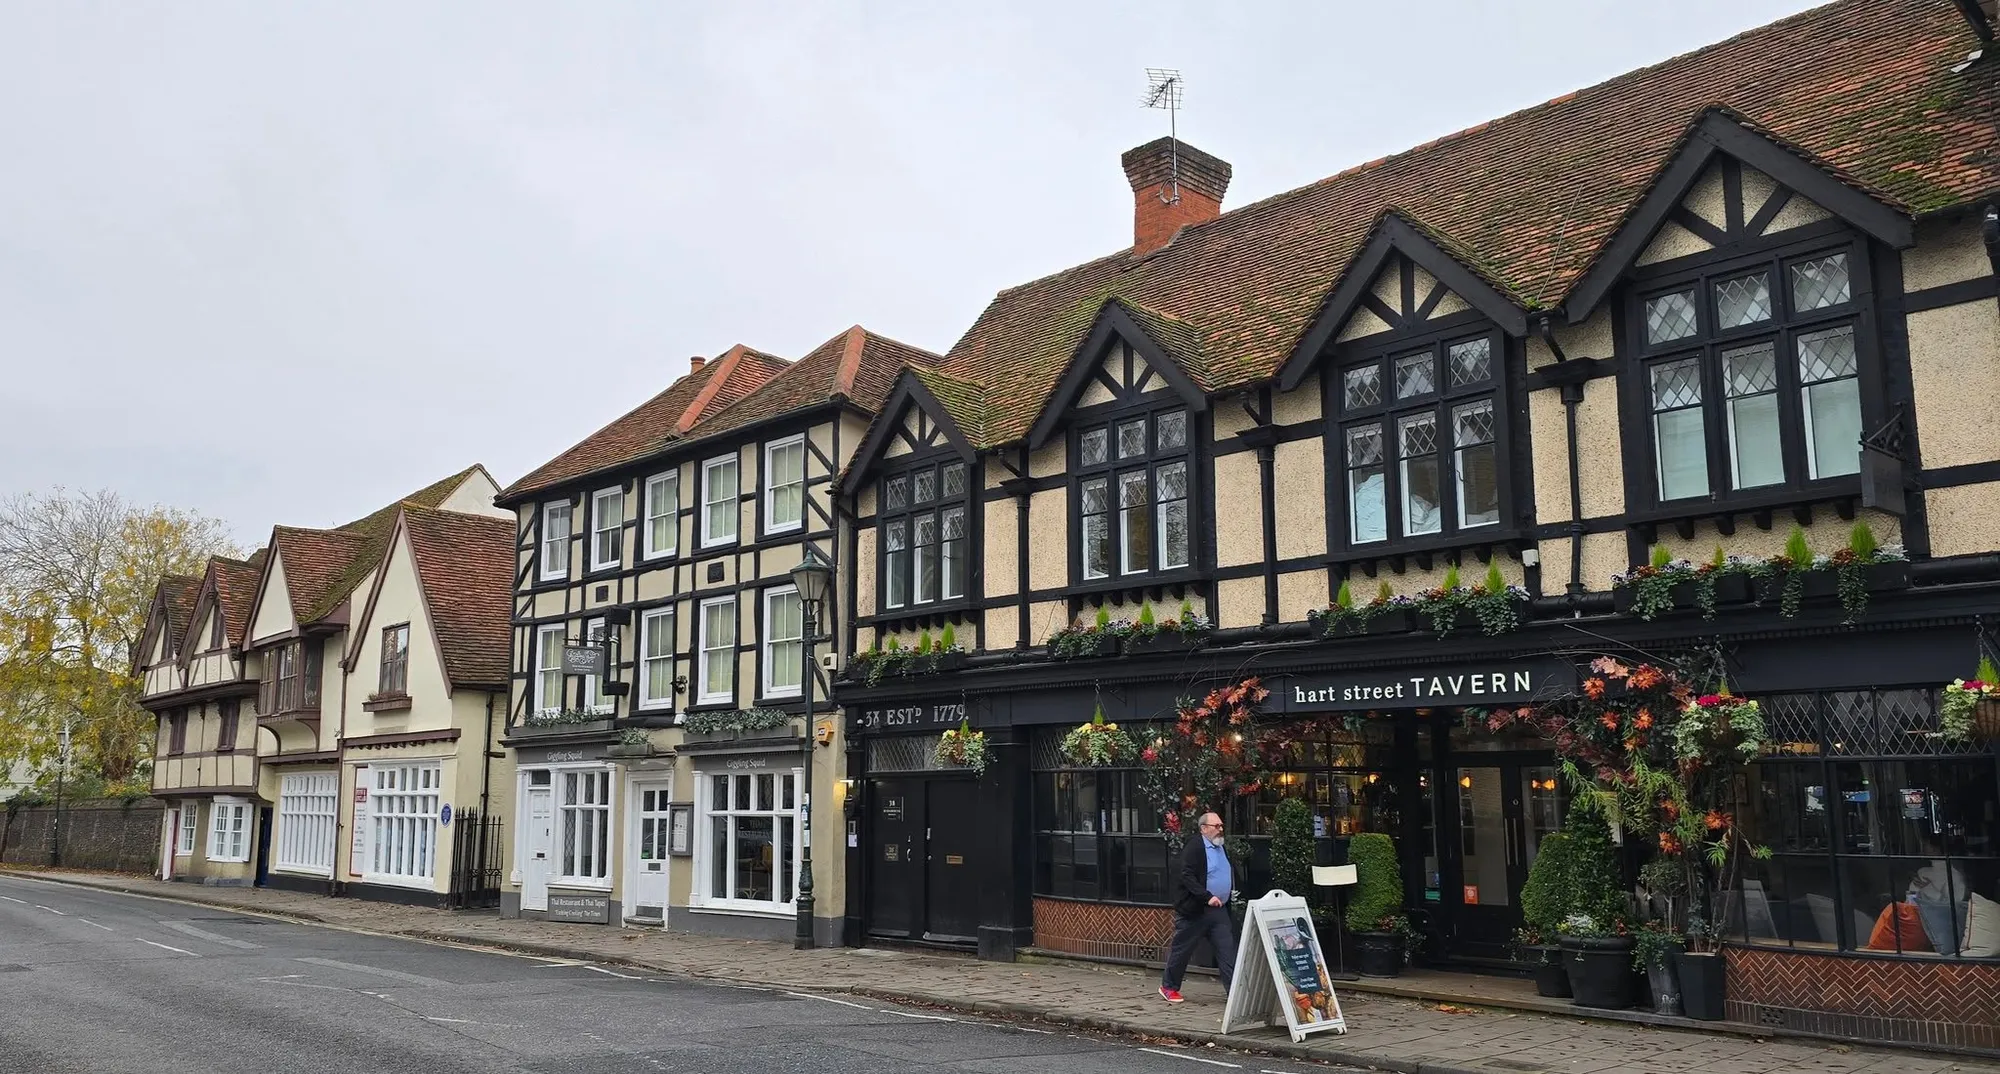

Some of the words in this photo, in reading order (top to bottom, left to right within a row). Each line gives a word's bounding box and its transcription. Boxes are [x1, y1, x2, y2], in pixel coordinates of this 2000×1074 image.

[1295, 686, 1335, 703] hart
[1344, 682, 1403, 701] street
[1410, 671, 1531, 697] TAVERN
[568, 750, 582, 761] Squid
[727, 759, 749, 770] Giggling
[750, 758, 765, 768] Squid
